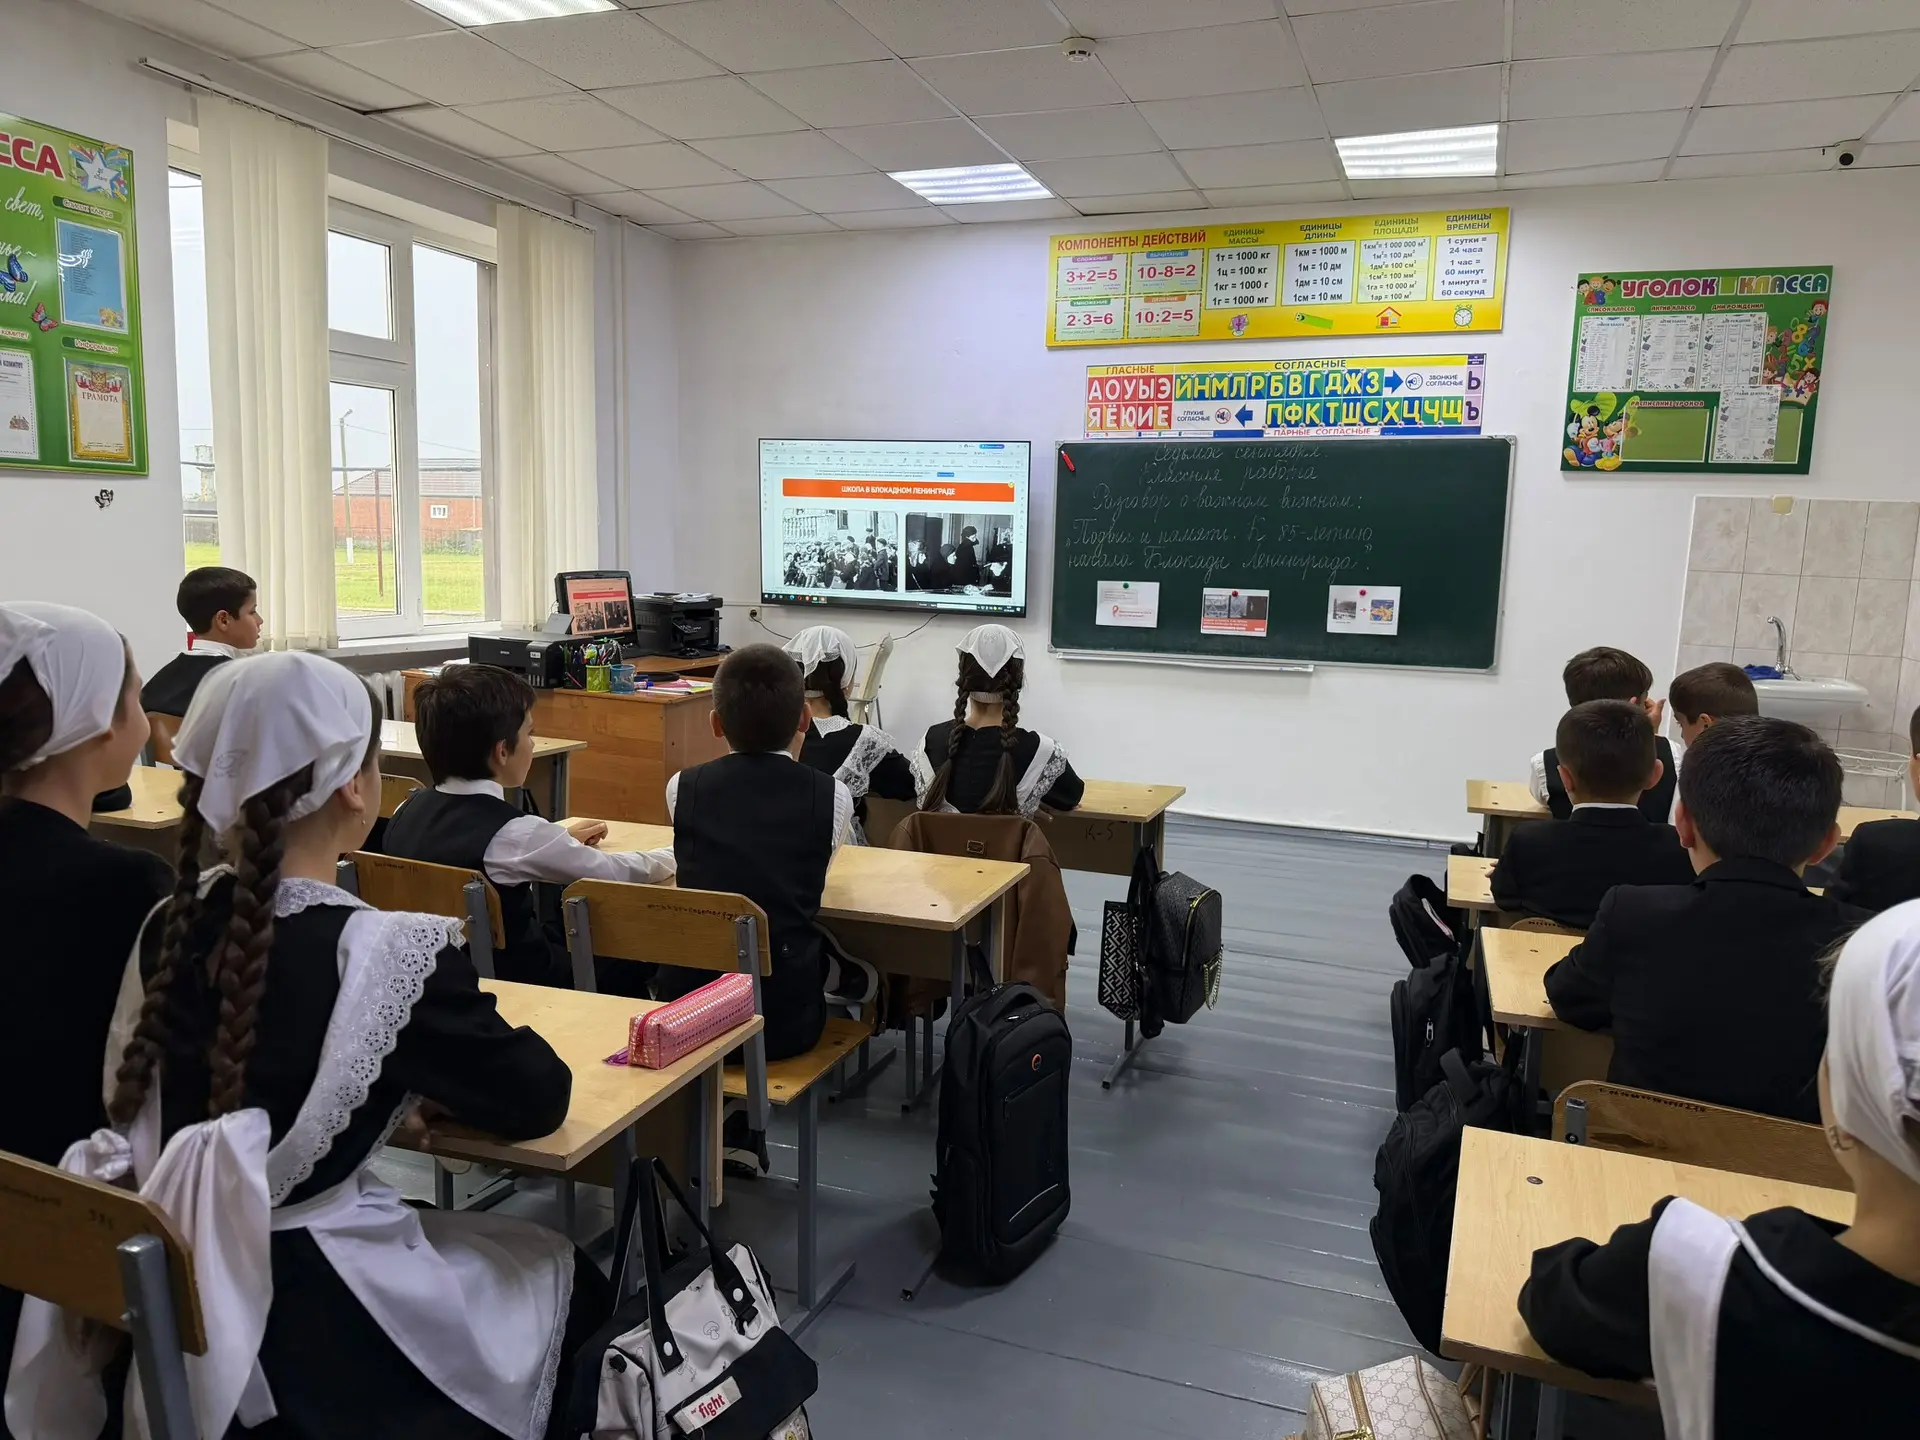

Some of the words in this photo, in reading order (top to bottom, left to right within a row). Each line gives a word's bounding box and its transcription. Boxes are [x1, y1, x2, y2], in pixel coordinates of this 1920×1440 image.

[1374, 218, 1418, 227] ЕДИНИЦЫ
[1446, 213, 1491, 222] ЕДИНИЦЫ
[1300, 223, 1342, 231] ЕДИНИЦЫ
[1224, 229, 1264, 237] ЕДИНИЦЫ
[1304, 232, 1336, 240] ДЛИНЫ
[1058, 235, 1138, 251] КОМПОНЕНТЫ
[1142, 230, 1206, 248] ДЕЙСТВИЙ
[1236, 251, 1258, 260] 1000
[1294, 248, 1309, 256] 1км
[1320, 246, 1338, 255] 1000
[1239, 266, 1255, 274] 100
[1298, 263, 1308, 271] 1м
[1319, 262, 1328, 270] 10
[1330, 263, 1341, 271] дм
[1066, 269, 1117, 283] 3+2=5
[1137, 265, 1196, 279] 10-8=2
[1214, 282, 1228, 290] 1кг
[1240, 281, 1261, 289] 1000
[1295, 278, 1310, 288] 1дм
[1320, 277, 1329, 285] 10
[1622, 277, 1717, 298] УГОЛОК
[1738, 274, 1828, 295] КЛАССА
[1213, 297, 1222, 305] 1г
[1233, 296, 1254, 304] 1000
[1294, 294, 1308, 302] 1см
[1319, 292, 1328, 300] 10
[1106, 365, 1154, 375] ГЛАСНЫЕ
[1275, 359, 1347, 371] СОГЛАСНЫЕ
[1425, 379, 1464, 387] СОГЛАСНЫЕ
[82, 392, 119, 403] ГРАМОТА
[1274, 428, 1310, 437] ПАРНЫЕ
[1315, 427, 1371, 436] СОГЛАСНЫЕ
[841, 484, 865, 494] ШКОЛА
[865, 486, 870, 494] В
[871, 486, 912, 496] БЛОКАДНОМ
[913, 486, 956, 496] ЛЕНИНГРАДЕ
[698, 1393, 726, 1419] fight
